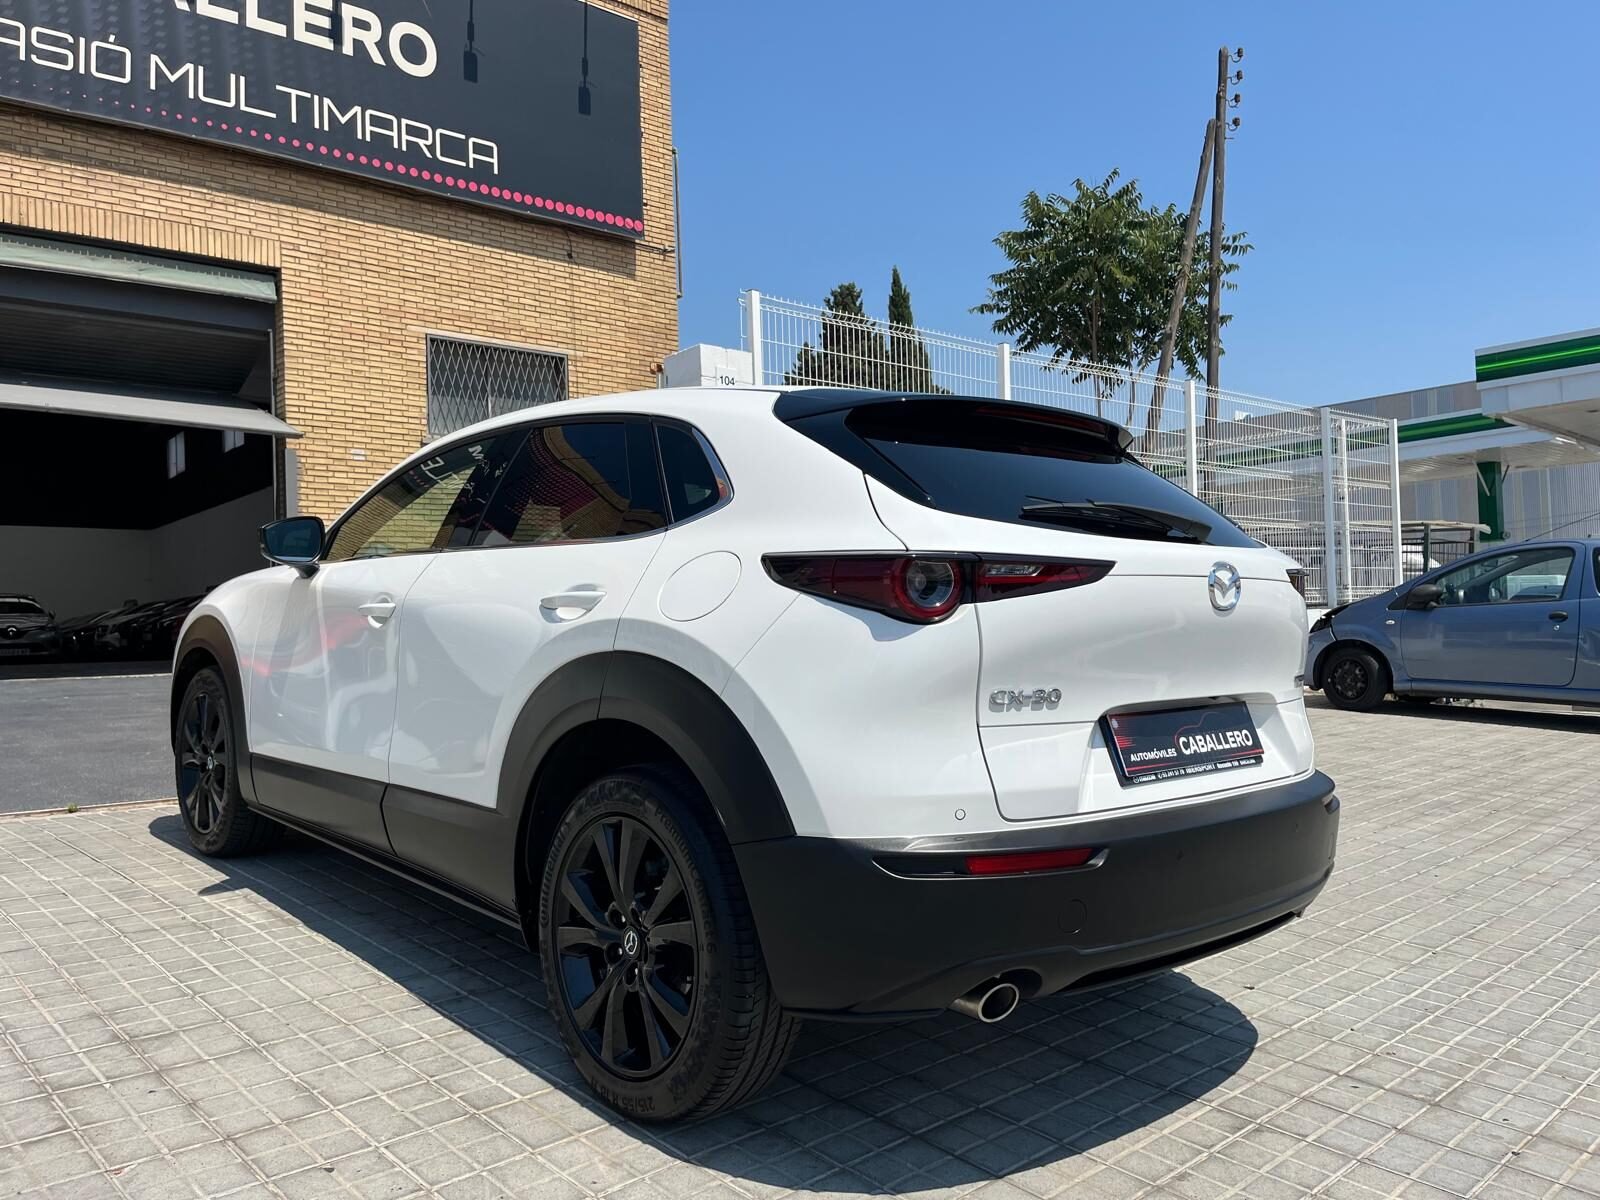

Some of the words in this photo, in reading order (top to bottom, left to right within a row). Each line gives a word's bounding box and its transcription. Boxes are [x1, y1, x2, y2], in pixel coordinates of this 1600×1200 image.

[150, 53, 499, 175] MULTIMARCA
[719, 375, 735, 386] 104
[988, 688, 1062, 710] CX-30
[1130, 748, 1177, 762] AUTOMÓVILES
[1179, 729, 1253, 755] CABALLERO
